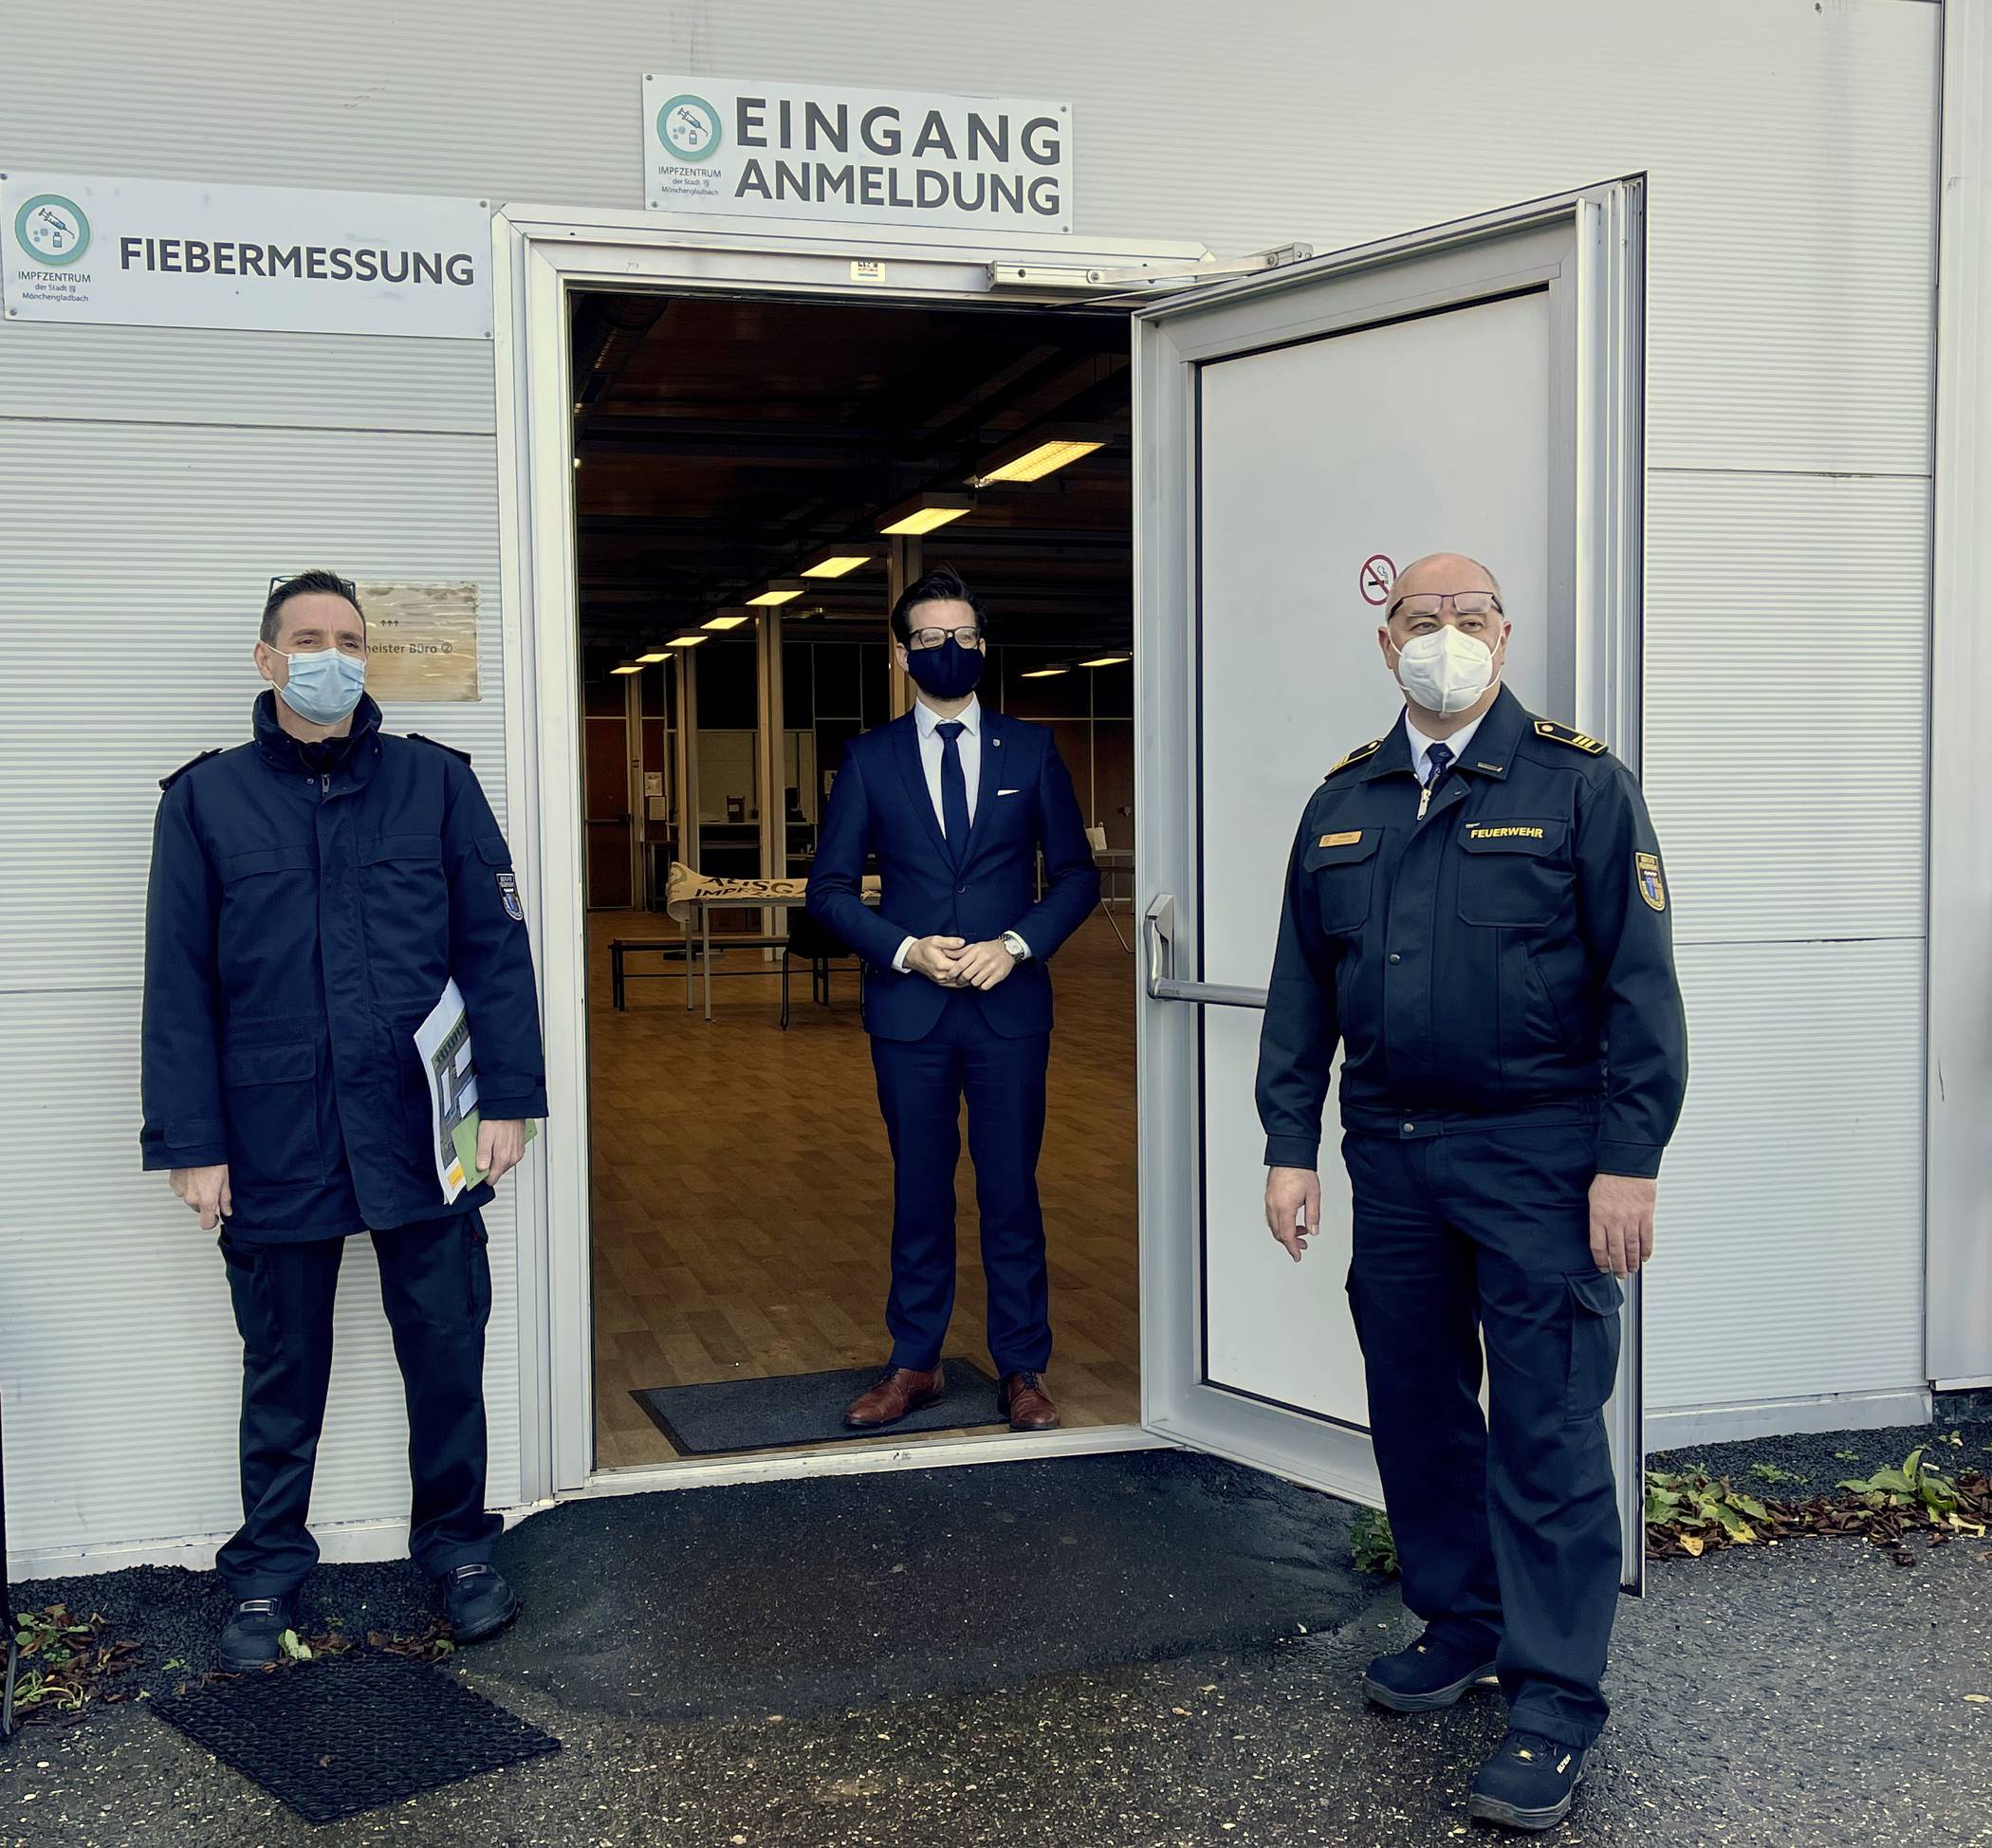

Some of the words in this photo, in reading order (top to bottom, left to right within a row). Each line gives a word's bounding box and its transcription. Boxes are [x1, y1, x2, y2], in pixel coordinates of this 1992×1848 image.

[736, 96, 1061, 166] EINGANG
[658, 166, 721, 177] IMPFZENTRUM
[733, 158, 1060, 216] ANMELDUNG
[120, 236, 474, 286] FIEBERMESSUNG
[17, 270, 91, 284] IMPFZENTRUM
[47, 284, 67, 292] Stadt
[22, 292, 89, 303] Mönchengladbach
[409, 643, 437, 654] Büro
[1471, 827, 1543, 839] FEUERWEHR
